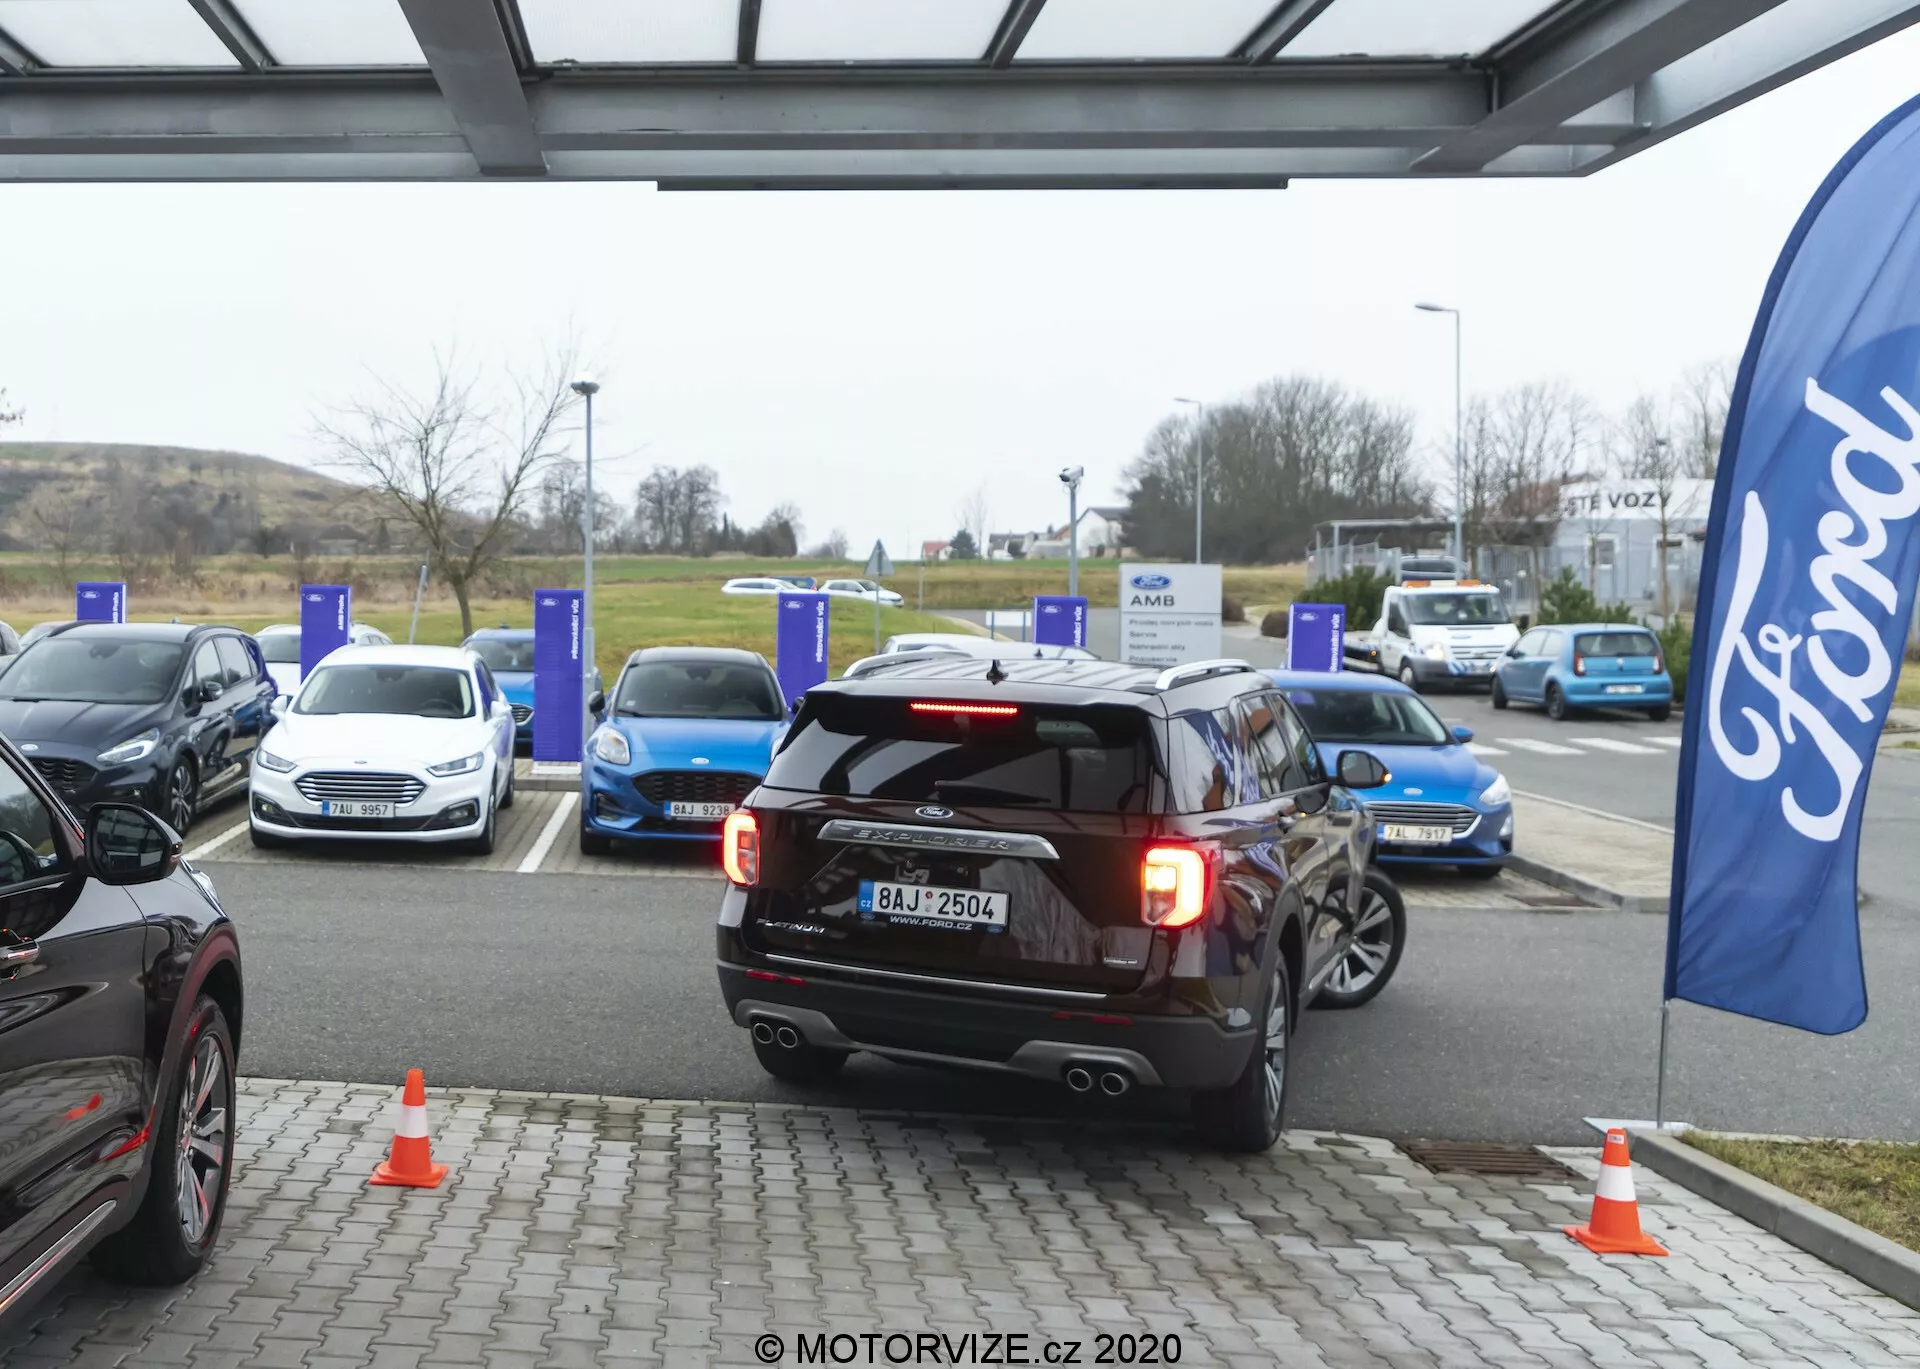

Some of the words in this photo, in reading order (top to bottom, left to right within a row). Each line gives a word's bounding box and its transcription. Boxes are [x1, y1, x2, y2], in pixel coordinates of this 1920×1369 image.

[1130, 594, 1175, 607] AMB
[1709, 376, 1920, 842] Ford
[331, 803, 353, 815] 7AU
[361, 804, 388, 815] 9957
[673, 803, 694, 815] 8AJ
[702, 804, 730, 816] 9238
[853, 829, 1010, 850] EXPLORER
[860, 899, 872, 908] CZ
[878, 886, 920, 912] 8AJ
[937, 892, 995, 920] 2504
[756, 917, 826, 934] PLATINUM
[890, 915, 973, 931] WWW.FORD.CZ
